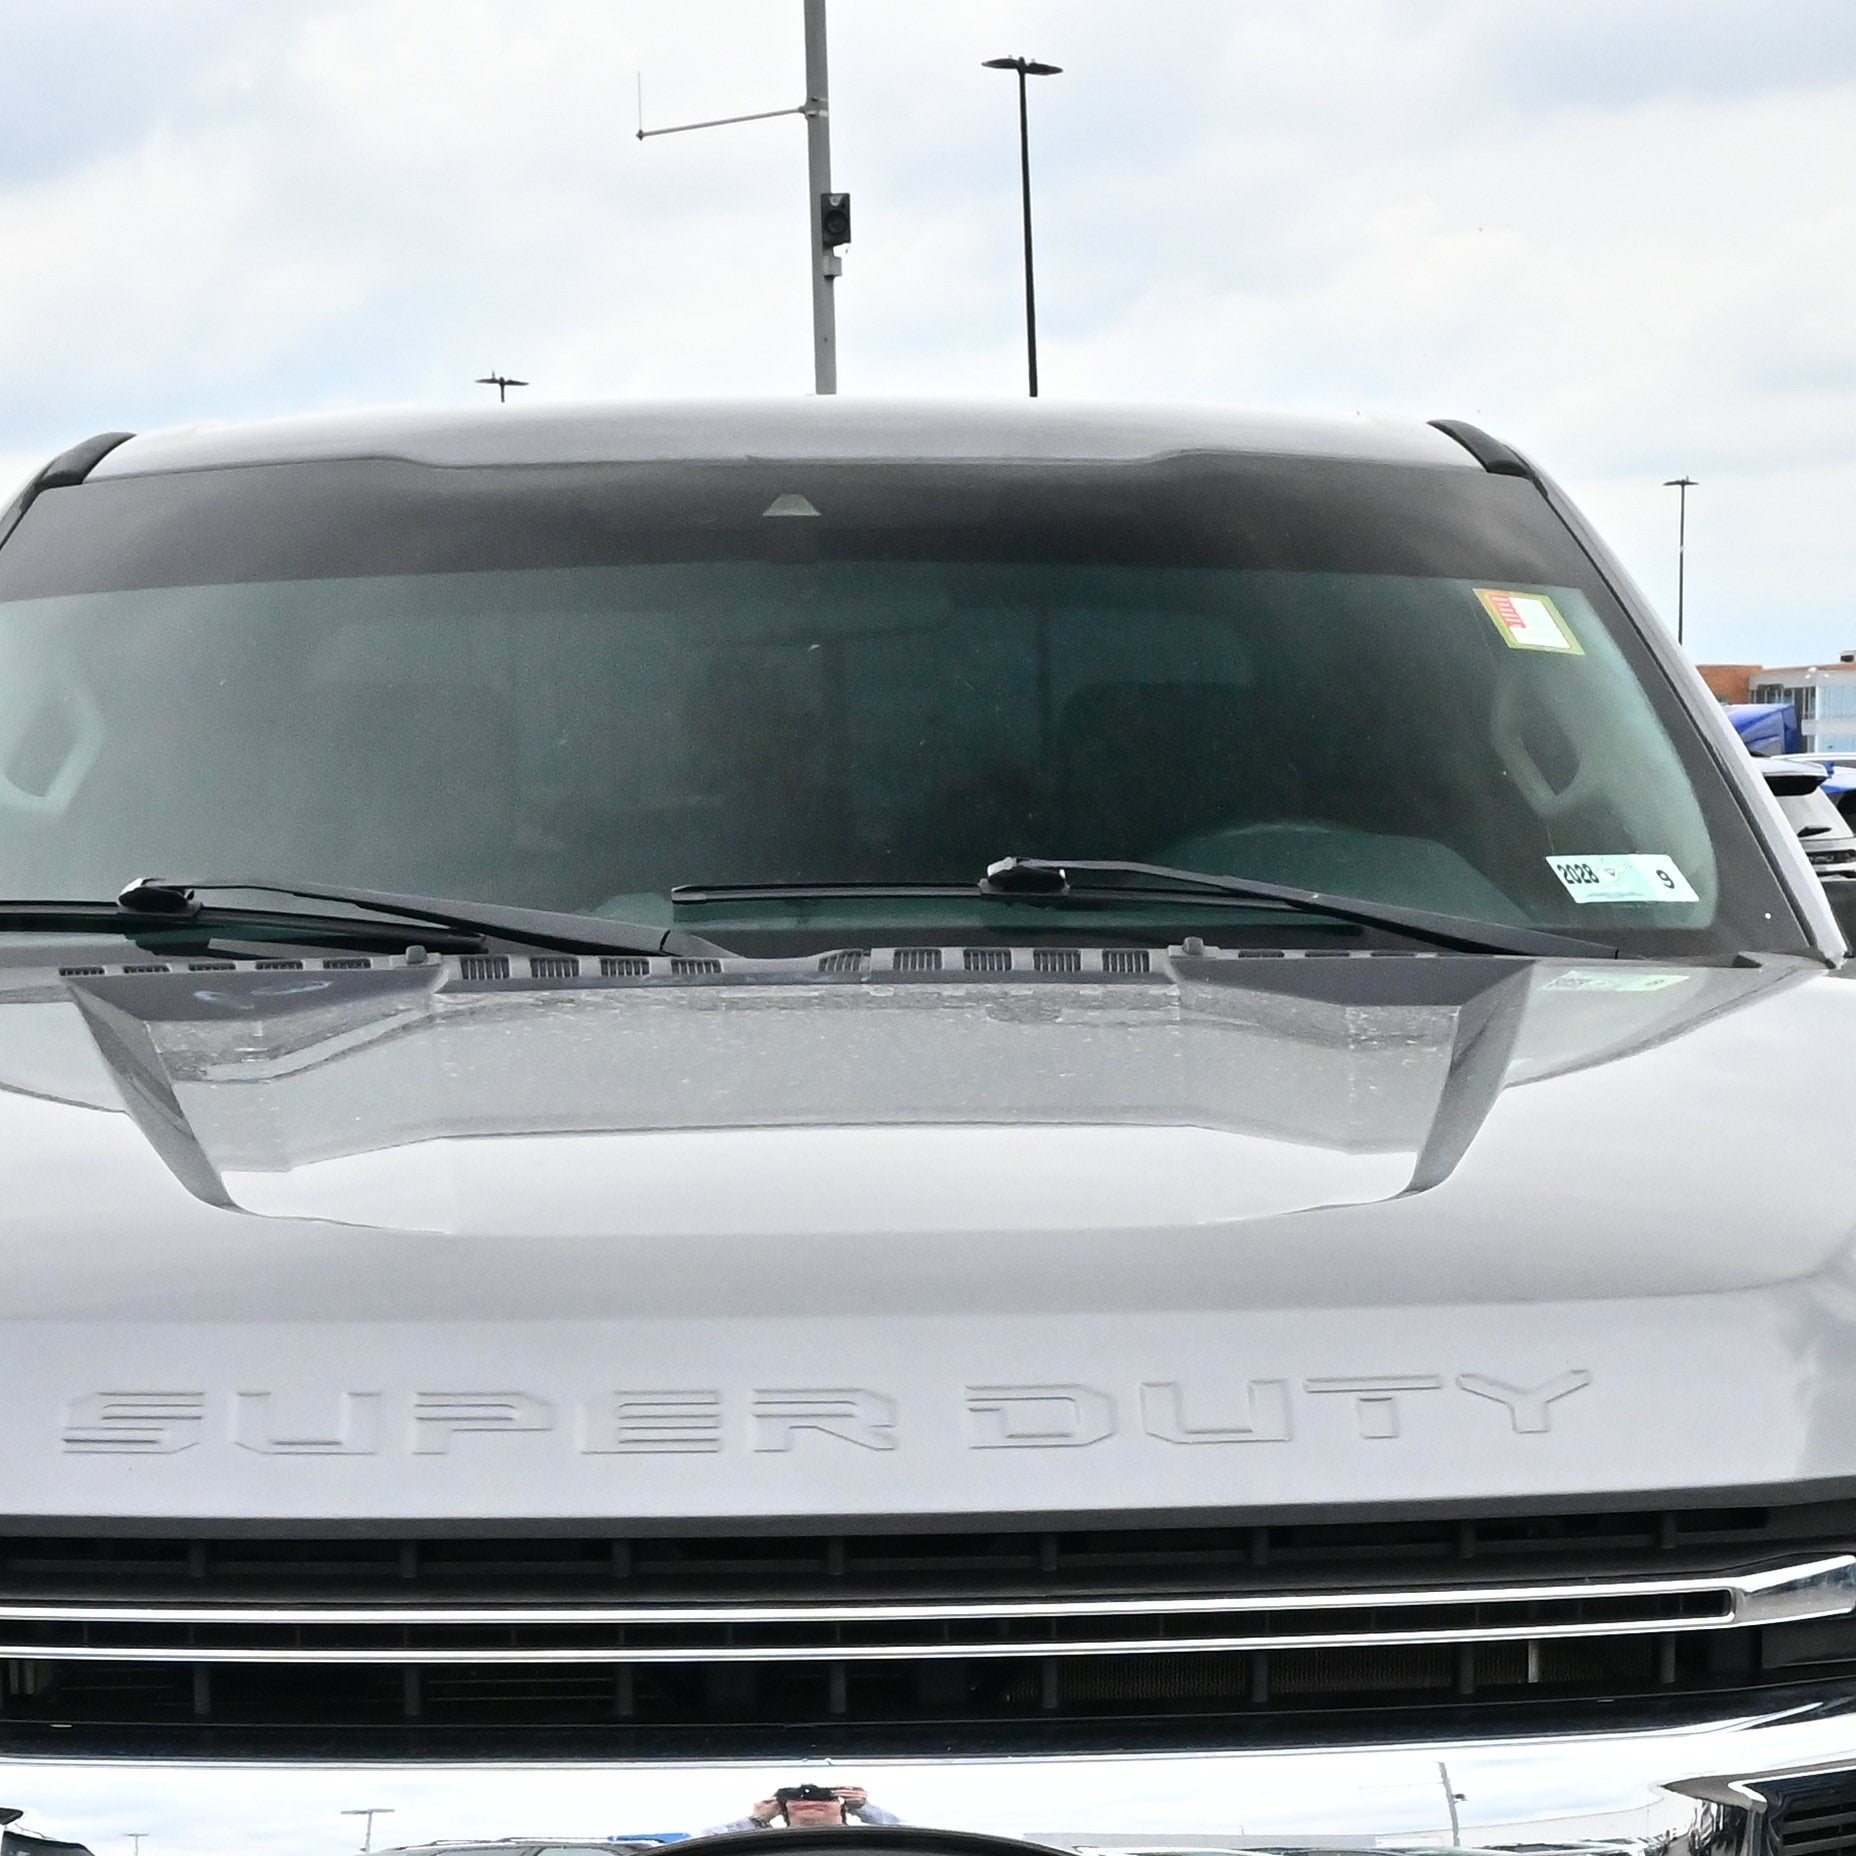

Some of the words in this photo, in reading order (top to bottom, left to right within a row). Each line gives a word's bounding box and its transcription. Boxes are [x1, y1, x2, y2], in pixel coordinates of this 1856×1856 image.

[1556, 863, 1600, 885] 2028
[61, 1387, 898, 1455] SUPER
[965, 1368, 1591, 1451] DUTY
